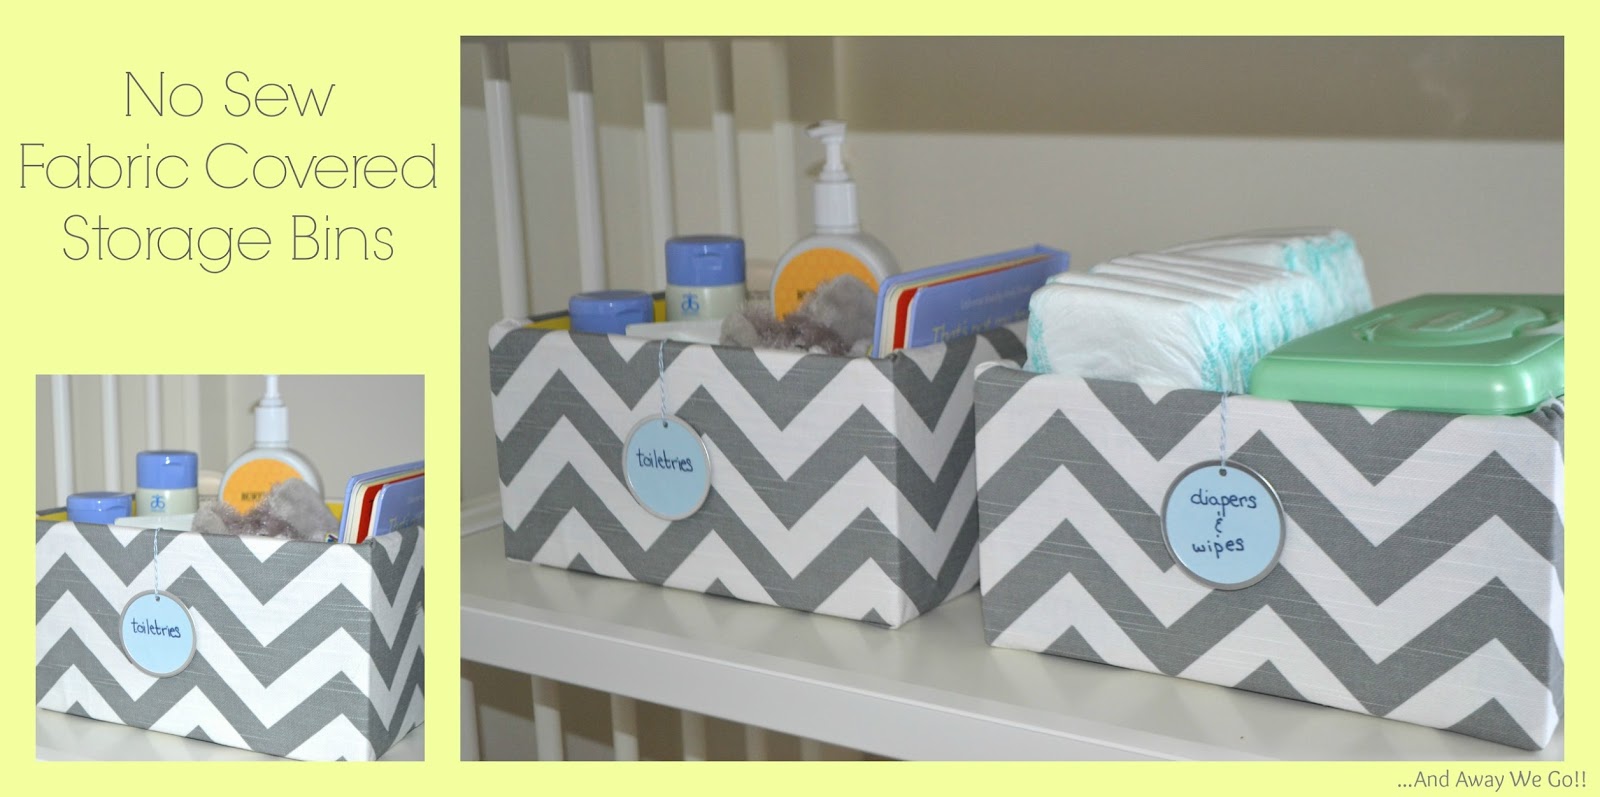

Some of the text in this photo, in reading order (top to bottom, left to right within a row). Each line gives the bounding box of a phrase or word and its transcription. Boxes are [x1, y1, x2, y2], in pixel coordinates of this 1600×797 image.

[635, 448, 695, 473] toiletries
[1190, 488, 1257, 517] diapers
[1192, 538, 1245, 559] wipes
[130, 617, 182, 639] toiletries
